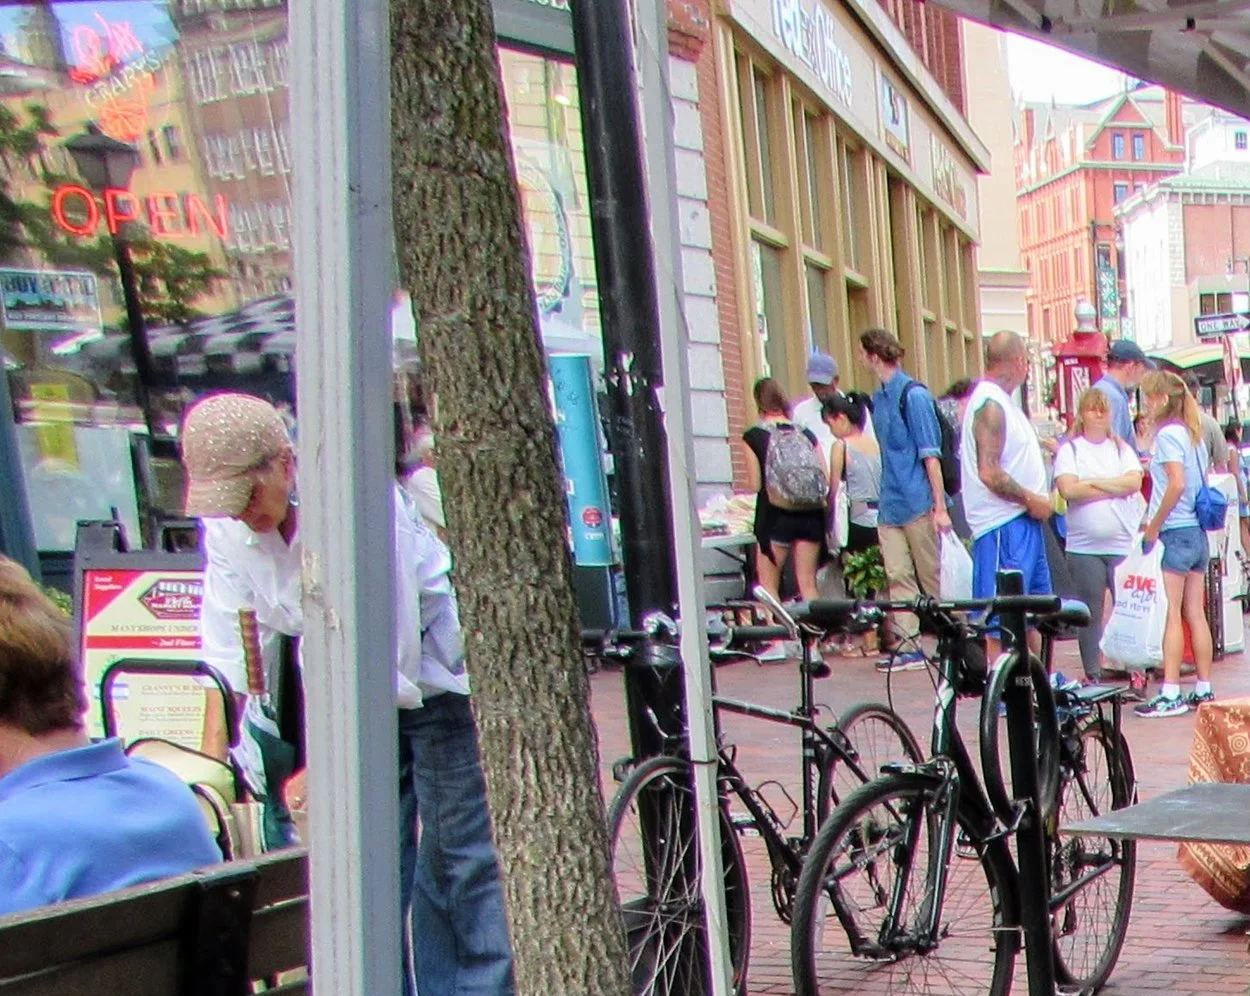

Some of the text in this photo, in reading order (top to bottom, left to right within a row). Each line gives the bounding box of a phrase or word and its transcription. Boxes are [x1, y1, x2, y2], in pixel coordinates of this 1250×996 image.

[52, 184, 229, 241] OPEN
[1200, 319, 1241, 331] ONE WAY
[1123, 574, 1157, 591] ave
